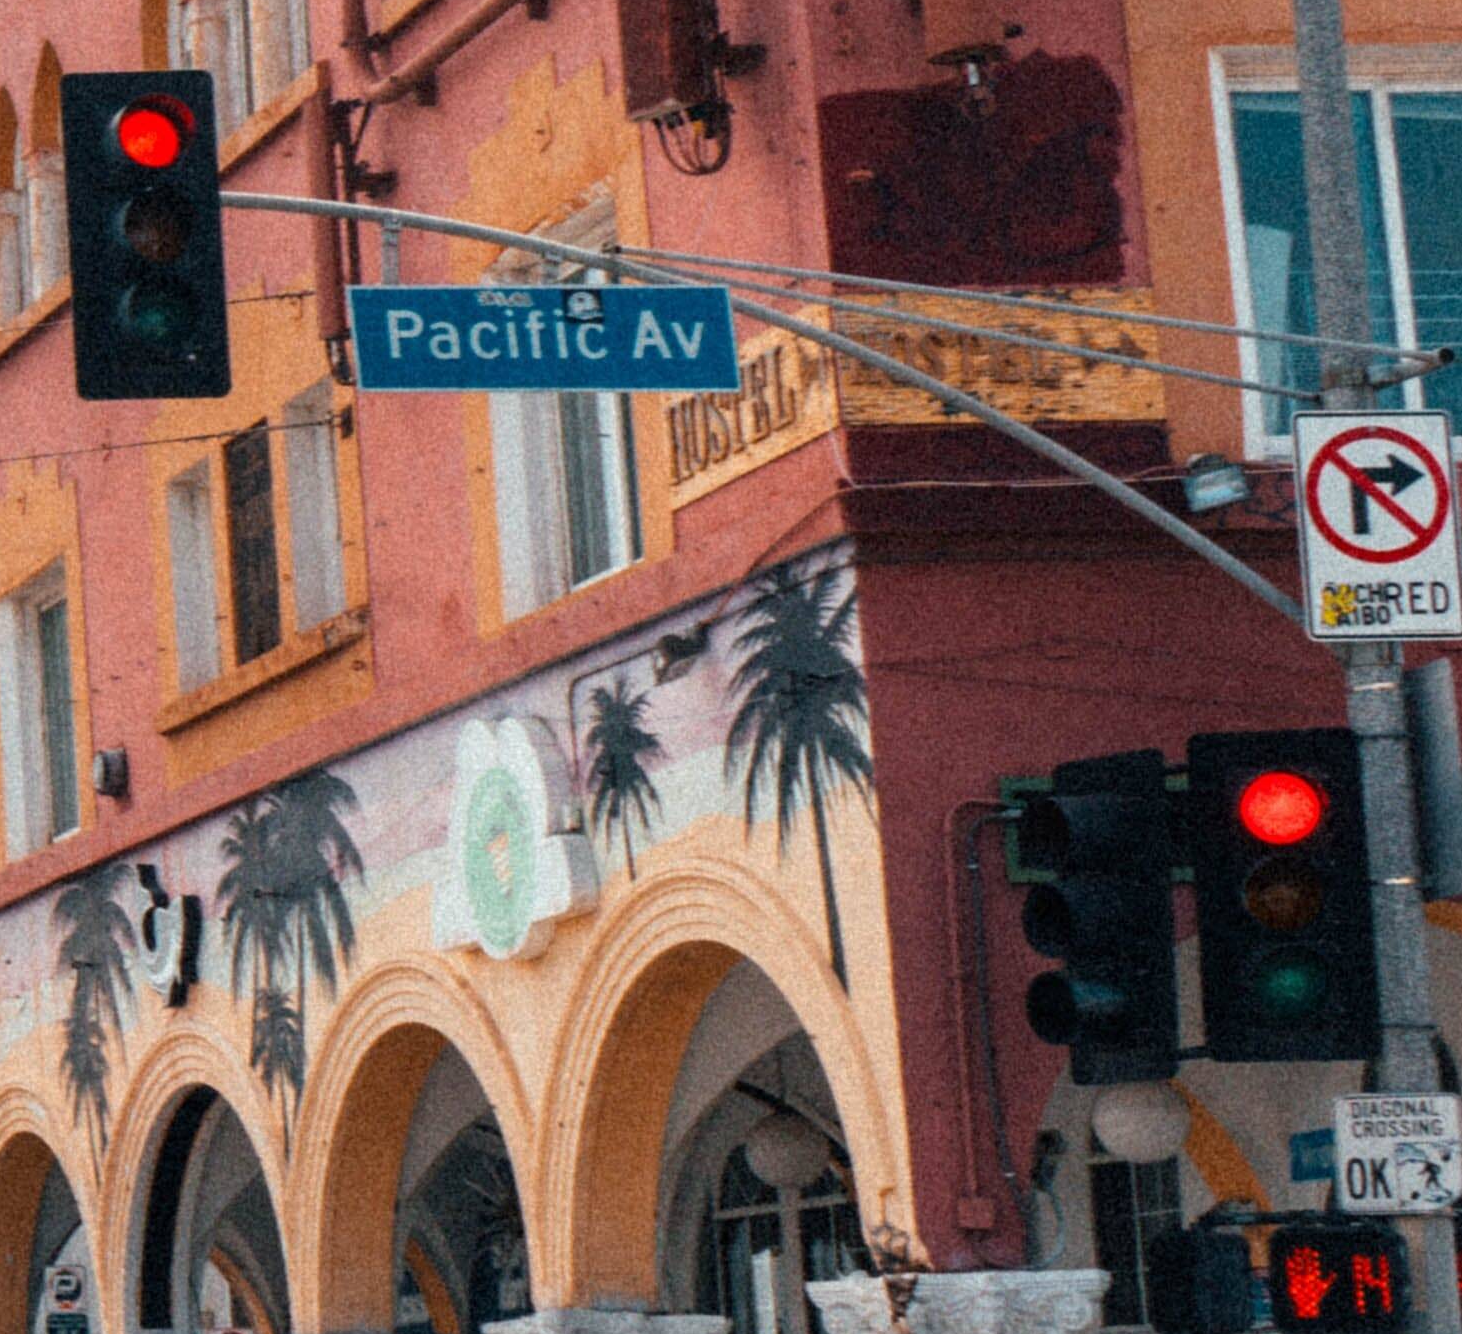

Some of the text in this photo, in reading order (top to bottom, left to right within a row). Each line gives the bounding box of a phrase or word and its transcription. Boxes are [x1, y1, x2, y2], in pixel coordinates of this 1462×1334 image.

[386, 309, 704, 361] Pacific Av
[668, 346, 796, 487] HOSTEL
[1385, 581, 1450, 615] RED
[1349, 1099, 1440, 1118] DIAGONAL
[1352, 1118, 1445, 1139] CROSSING
[1346, 1157, 1392, 1200] OK
